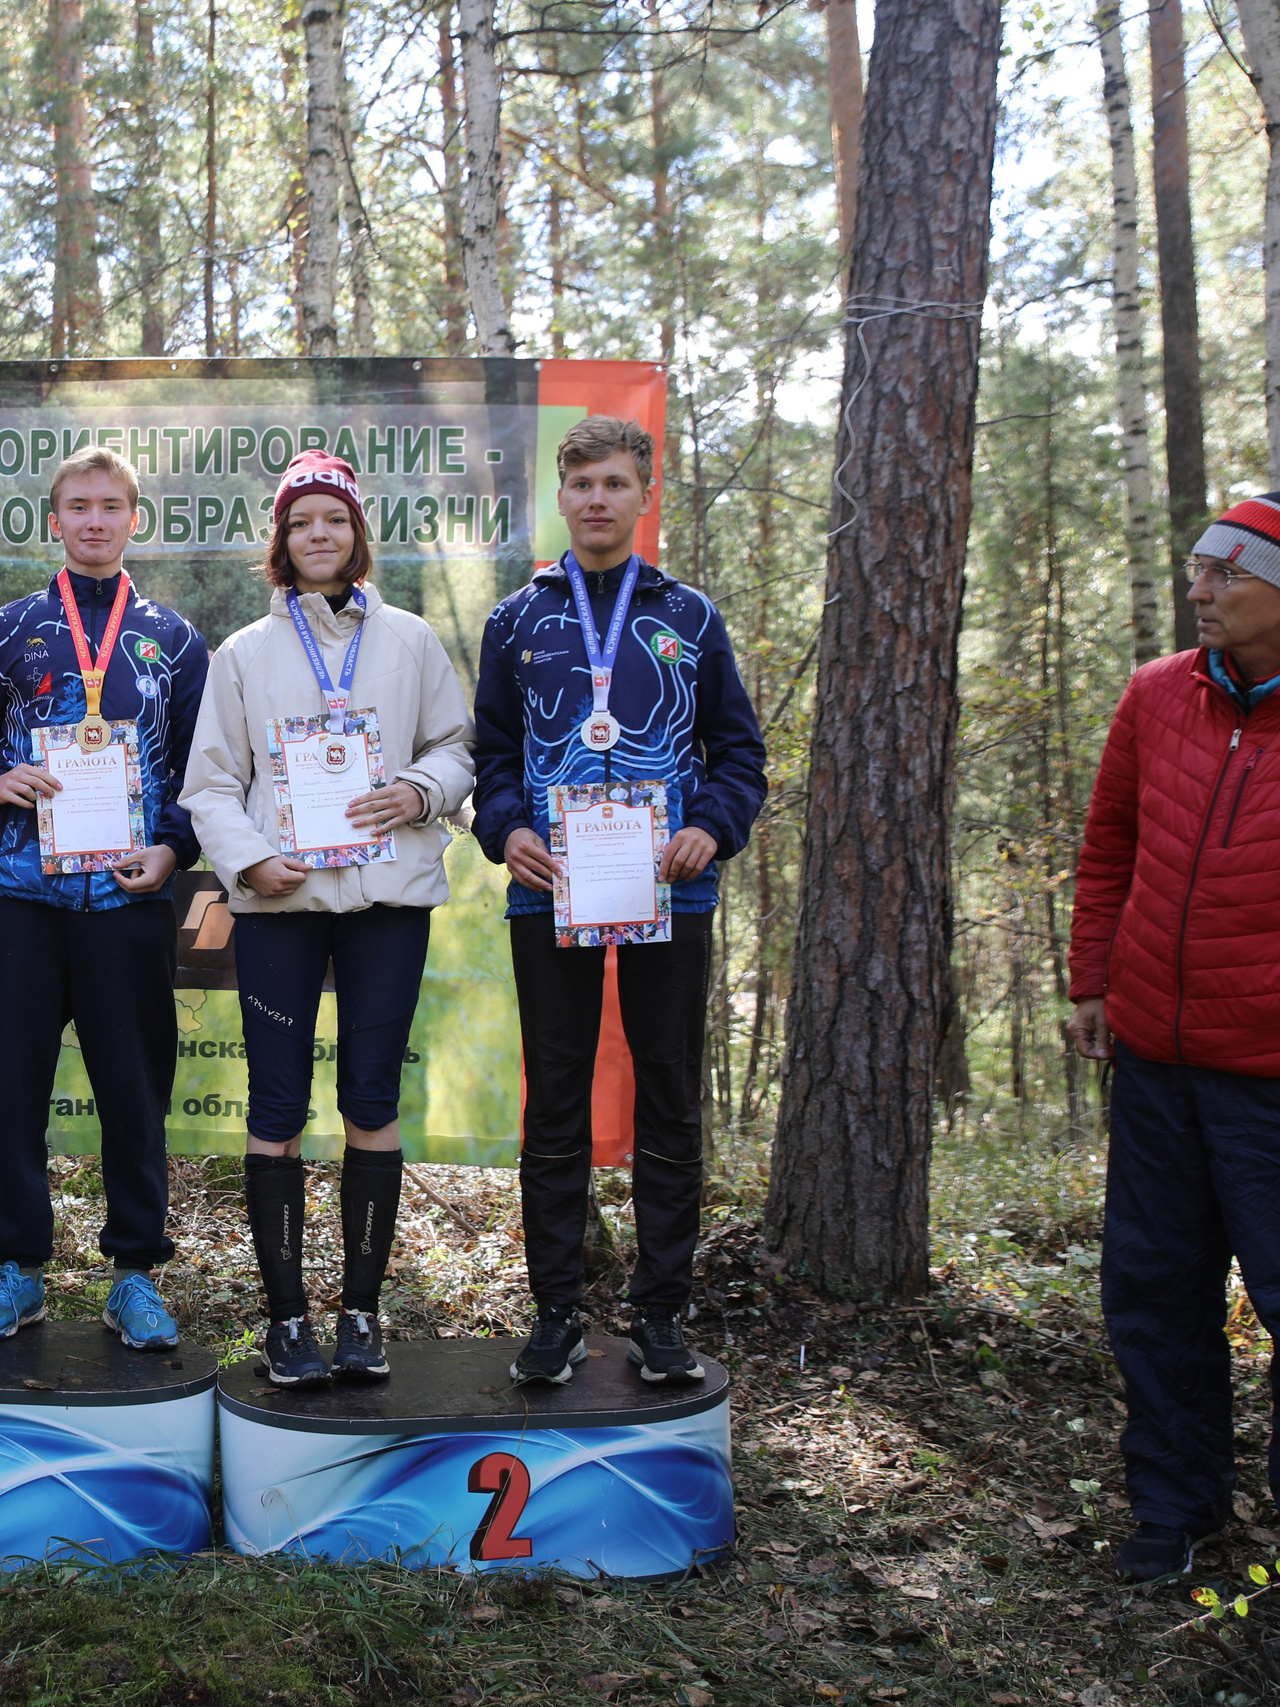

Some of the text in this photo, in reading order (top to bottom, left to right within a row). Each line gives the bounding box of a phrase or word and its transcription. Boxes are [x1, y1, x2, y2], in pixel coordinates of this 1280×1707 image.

[290, 469, 362, 504] adid
[128, 495, 275, 545] ОБРАЗ
[24, 650, 49, 662] DINA
[57, 756, 117, 769] ГРАМОТА
[575, 820, 642, 833] ГРАМОТА
[468, 1452, 532, 1560] 2
